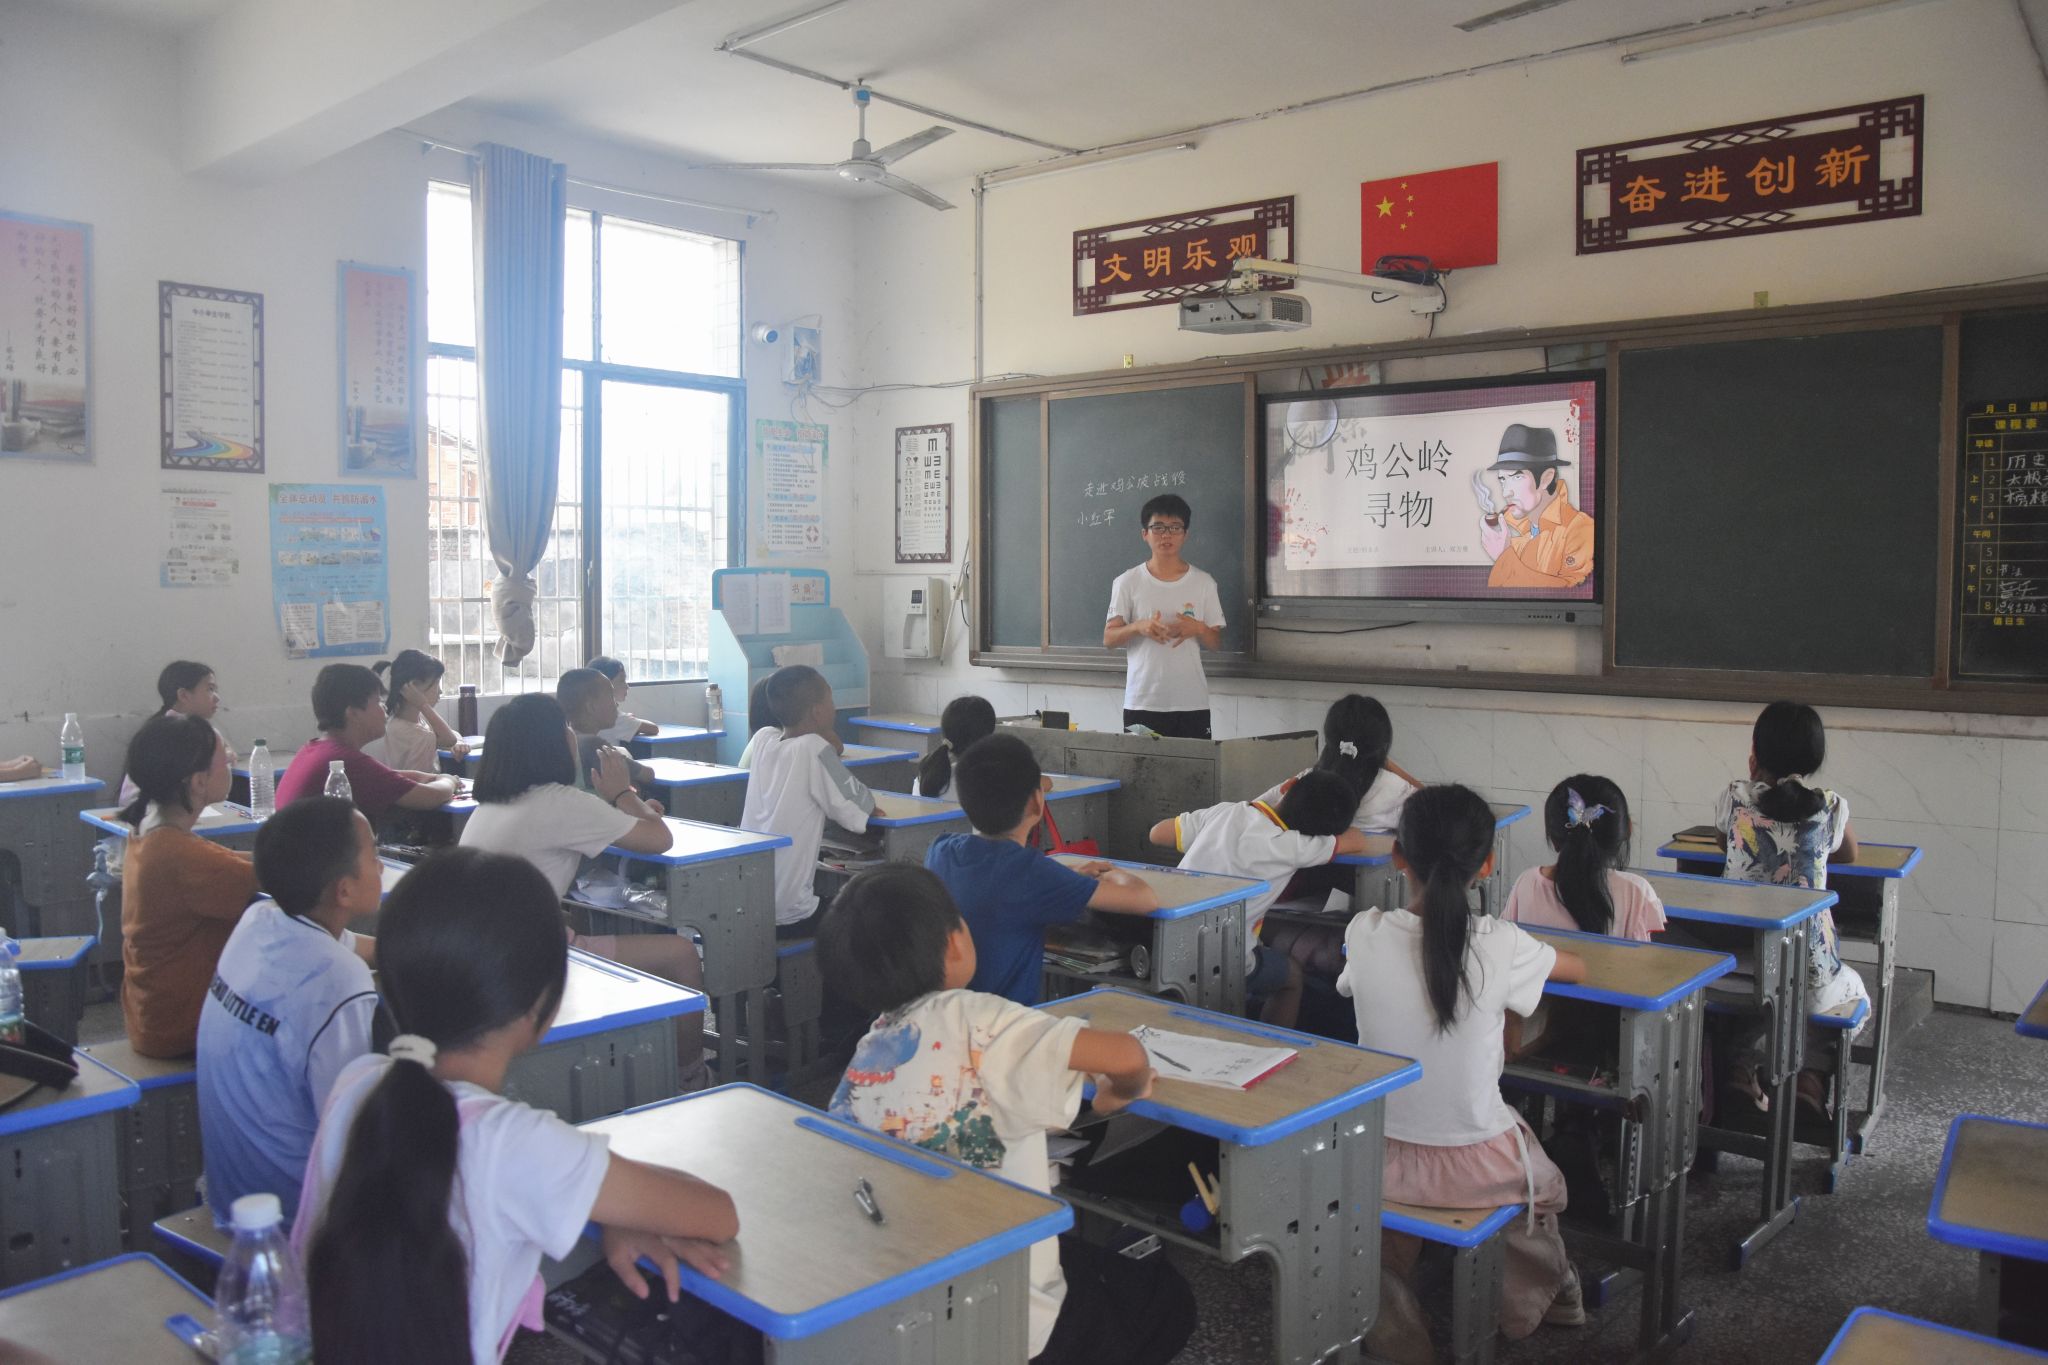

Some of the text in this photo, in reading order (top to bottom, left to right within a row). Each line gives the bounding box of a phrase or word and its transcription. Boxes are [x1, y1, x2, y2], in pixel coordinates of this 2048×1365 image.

[1618, 144, 1871, 213] 奋进创新
[1100, 233, 1262, 284] 文明乐观
[1985, 404, 1994, 414] 月
[2008, 403, 2017, 413] 日
[1345, 439, 1453, 481] 鸡公岭
[1989, 456, 1996, 467] 1
[2007, 454, 2047, 471] 历史
[1988, 475, 1996, 485] 2
[1988, 494, 1995, 503] 3
[1363, 490, 1433, 529] 寻物
[1986, 547, 1993, 557] 5
[1985, 583, 1992, 593] 7
[1984, 601, 1992, 610] 8
[223, 989, 259, 1027] LITTLE
[256, 1012, 281, 1037] EN
